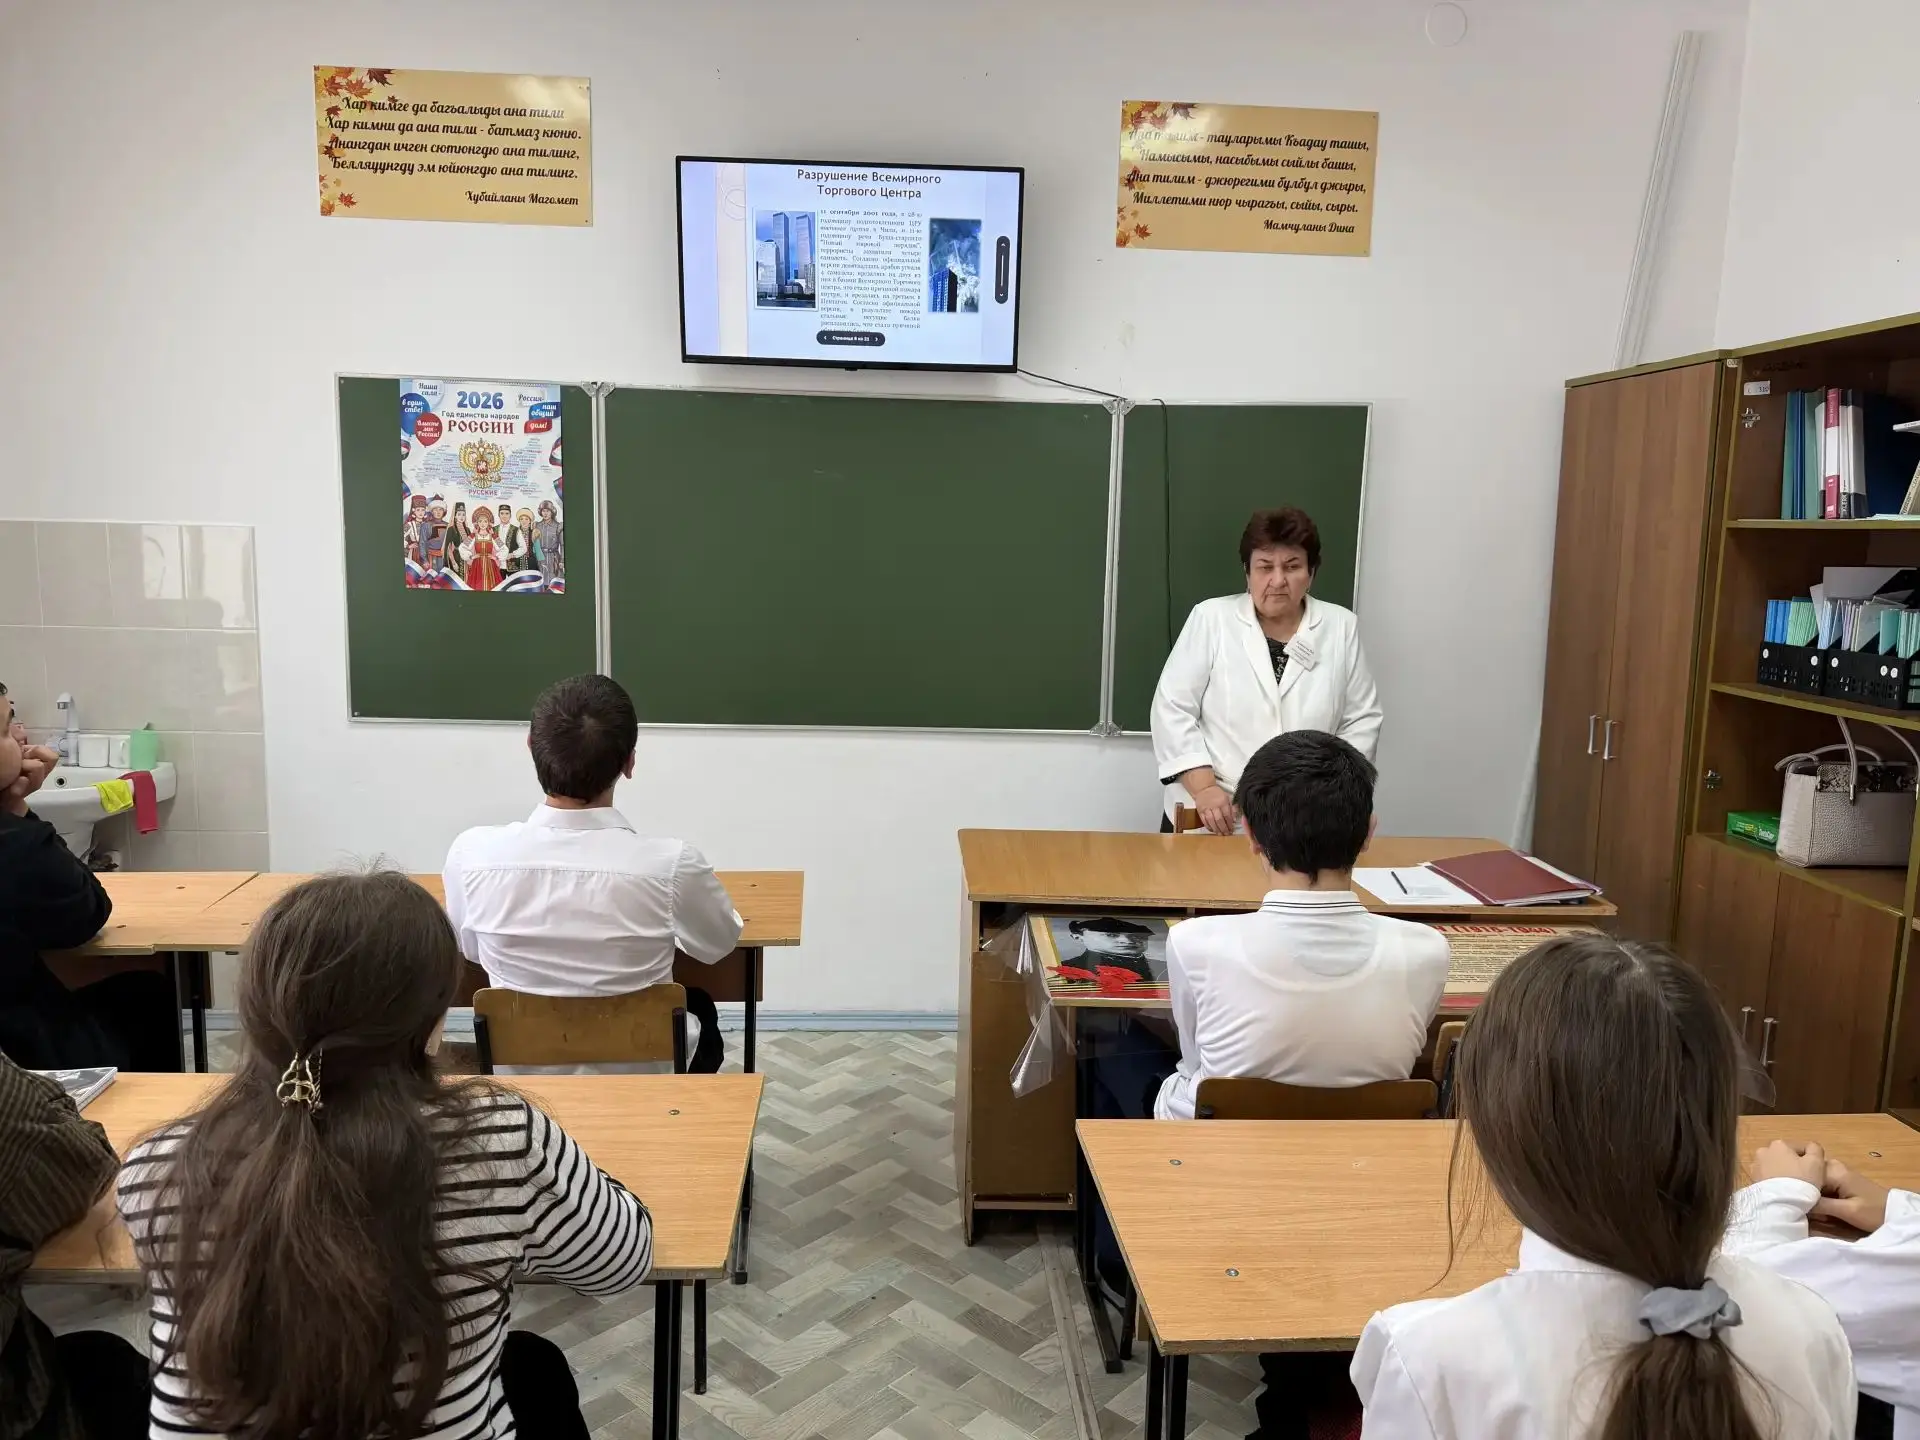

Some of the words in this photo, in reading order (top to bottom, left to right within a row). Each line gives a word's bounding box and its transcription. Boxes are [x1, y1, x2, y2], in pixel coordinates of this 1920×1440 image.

[342, 96, 366, 112] Хар
[370, 101, 408, 112] кимге
[412, 104, 427, 116] да
[430, 101, 500, 119] багъалыды
[504, 107, 526, 117] ана
[529, 108, 564, 118] тили
[325, 116, 350, 132] Хар
[353, 120, 395, 132] кимни
[398, 122, 413, 135] да
[416, 124, 440, 133] ана
[442, 124, 477, 134] тили
[488, 124, 540, 140] батмаз
[542, 129, 582, 140] кюню.
[329, 136, 390, 154] Анангдан
[394, 142, 428, 152] ичген
[430, 144, 499, 158] сютюнгдю
[502, 146, 526, 156] ана
[528, 148, 580, 160] тилинг,
[1206, 134, 1282, 147] тауларымы
[1284, 134, 1327, 151] Къадау
[1329, 140, 1369, 152] ташы,
[331, 157, 414, 175] Белляуунгду
[417, 163, 436, 172] эм
[438, 162, 498, 178] юйюнгдю
[500, 166, 524, 176] ана
[526, 168, 578, 178] тилинг.
[1140, 149, 1212, 164] Намысымы,
[1215, 154, 1278, 167] насыбымы
[1281, 157, 1320, 168] сыйлы
[1321, 158, 1356, 172] башы,
[797, 169, 868, 182] Разрушение
[872, 172, 942, 186] Всемирного
[1127, 170, 1150, 182] Ана
[1152, 174, 1195, 184] тилим
[1205, 176, 1274, 189] джюрегими
[1277, 177, 1318, 192] булбул
[1320, 182, 1366, 194] джыры,
[465, 190, 526, 204] Хубийланы
[528, 193, 578, 205] Магомет
[817, 184, 877, 198] Торгового
[880, 187, 922, 200] Центра
[1133, 192, 1206, 206] Миллетими
[1208, 197, 1232, 210] нюр
[1235, 198, 1288, 211] чырагъы,
[1290, 200, 1322, 212] сыйы,
[1326, 202, 1358, 215] сыры.
[1264, 220, 1326, 234] Мамчуланы
[1328, 222, 1354, 233] Дина
[457, 390, 504, 410] 2026
[442, 410, 454, 418] Год
[530, 408, 554, 418] общий
[448, 420, 515, 434] РОССИИ
[530, 422, 548, 430] дом!
[468, 488, 498, 496] РУССКИЕ
